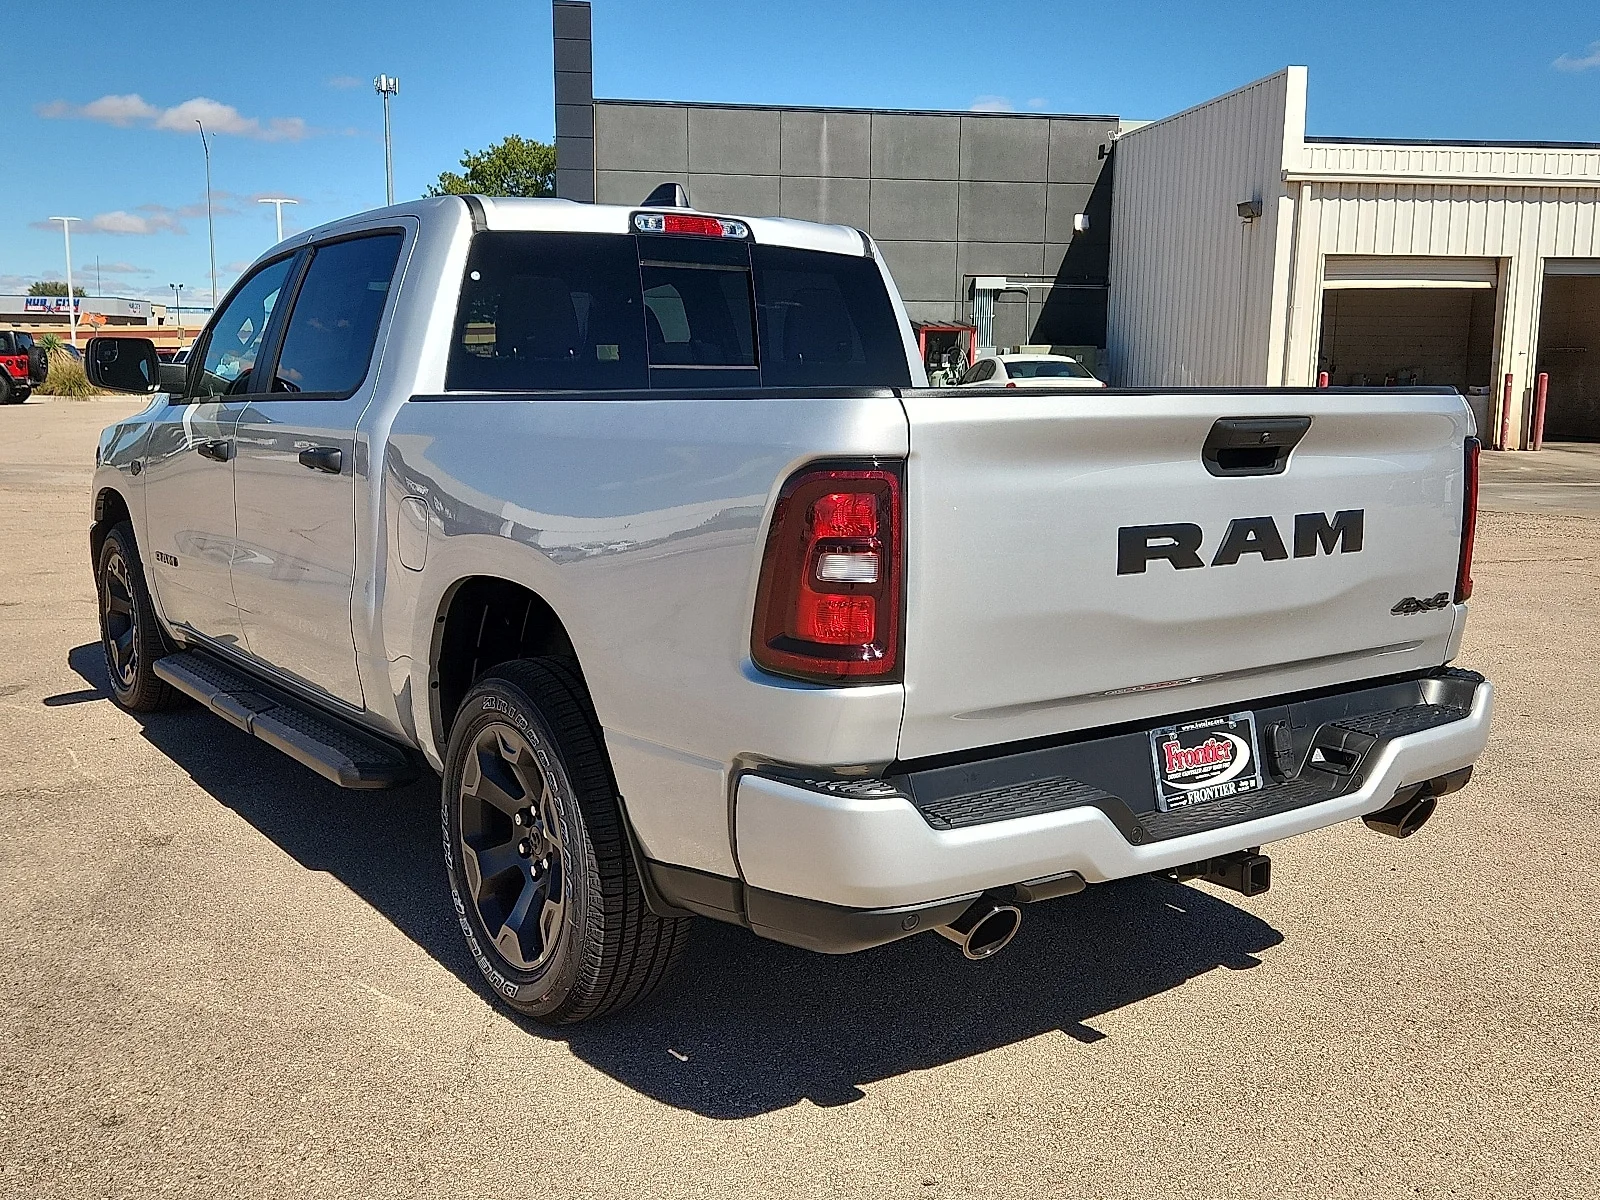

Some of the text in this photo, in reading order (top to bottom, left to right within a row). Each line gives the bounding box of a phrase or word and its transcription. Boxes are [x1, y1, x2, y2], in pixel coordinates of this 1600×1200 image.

[1117, 509, 1364, 575] RAM
[1163, 739, 1232, 772] Frontier
[1187, 782, 1237, 805] FRONTIER
